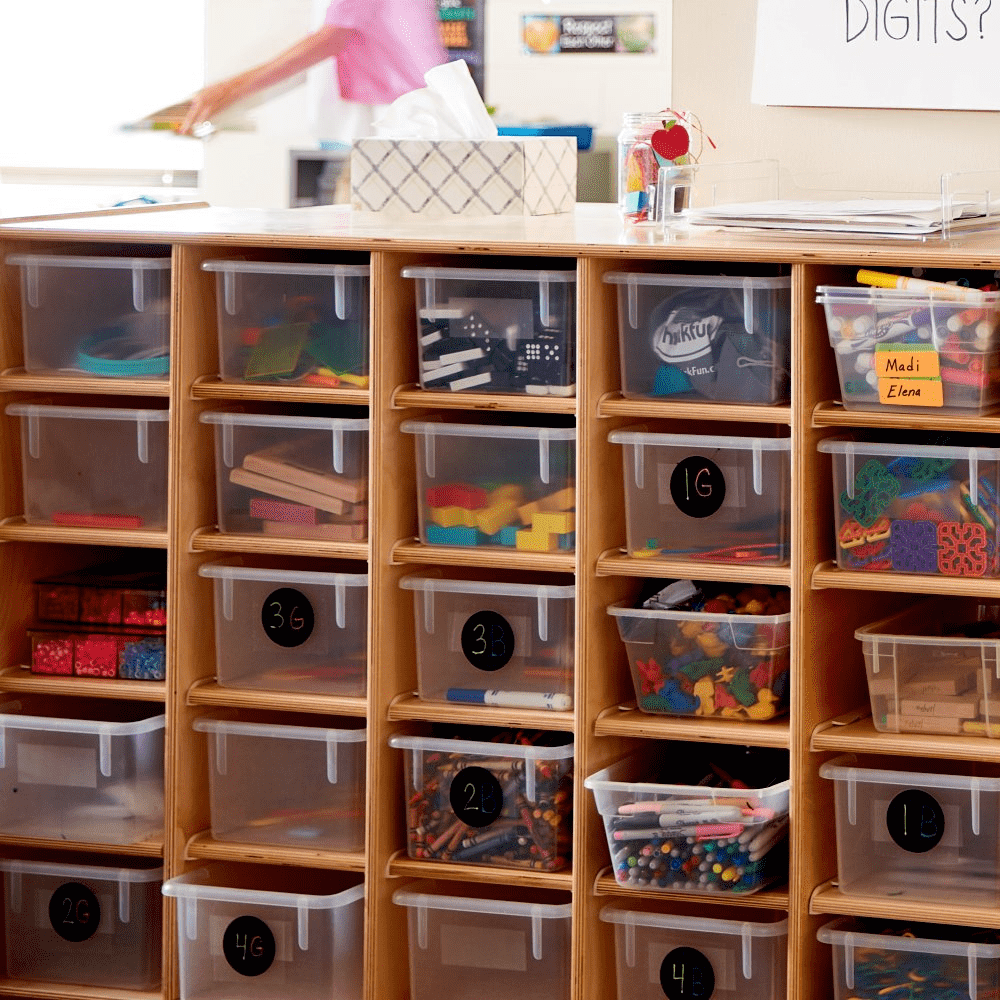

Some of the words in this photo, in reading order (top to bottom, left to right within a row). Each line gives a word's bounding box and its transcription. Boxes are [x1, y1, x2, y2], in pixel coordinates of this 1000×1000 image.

[886, 356, 919, 372] Madi
[887, 385, 921, 398] Elena
[270, 601, 305, 630] 3G
[472, 624, 505, 657] 3B
[464, 783, 496, 813] 2B
[62, 898, 90, 924] 2G
[236, 933, 264, 960] 4G
[672, 963, 705, 997] 4B
